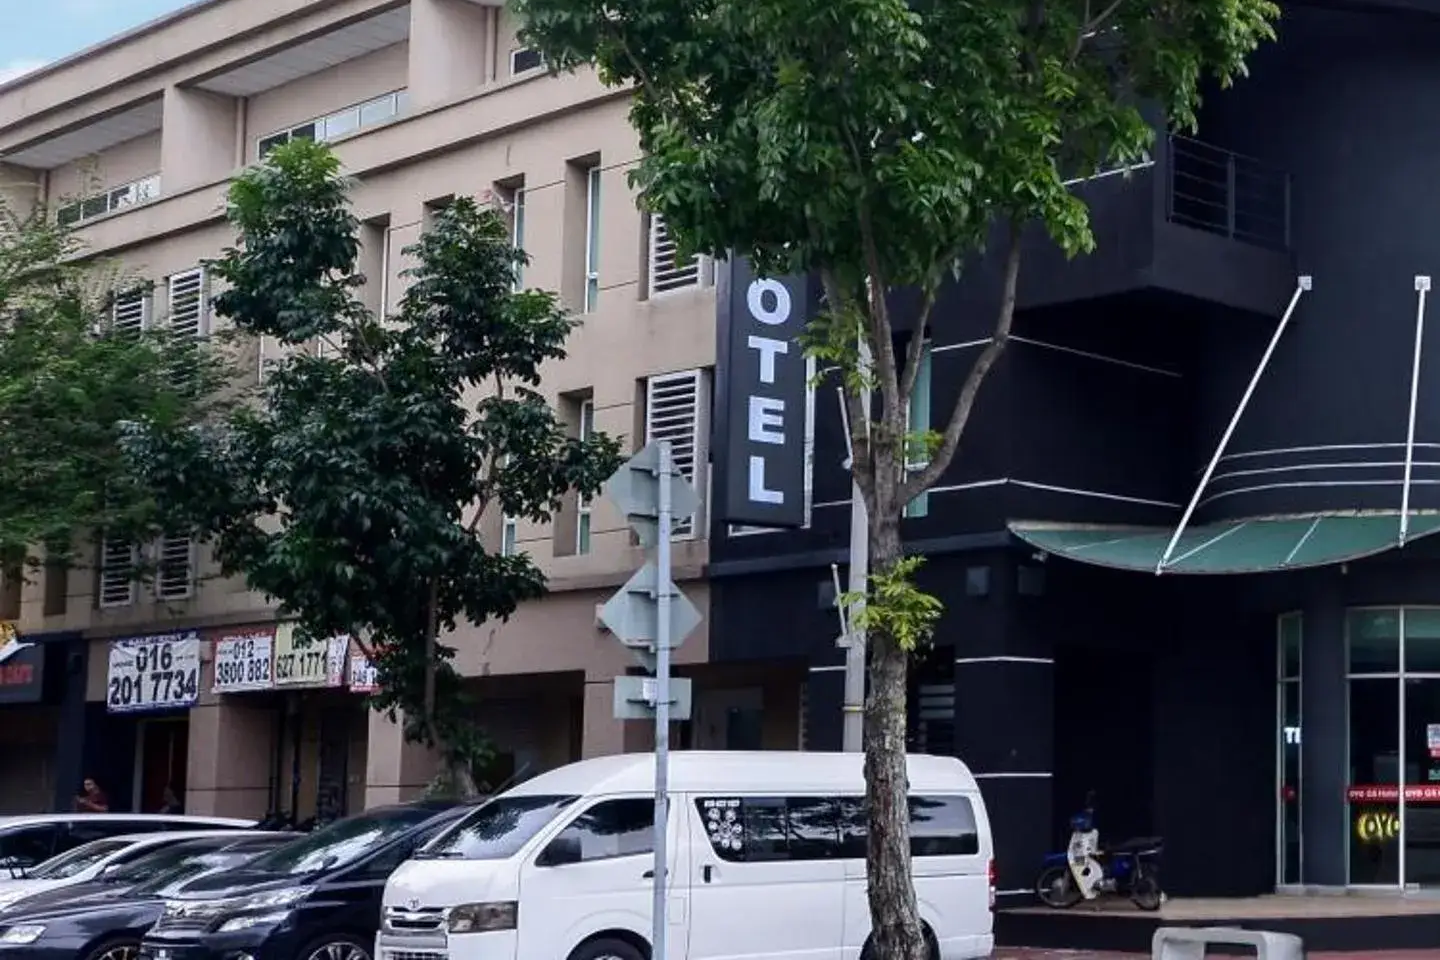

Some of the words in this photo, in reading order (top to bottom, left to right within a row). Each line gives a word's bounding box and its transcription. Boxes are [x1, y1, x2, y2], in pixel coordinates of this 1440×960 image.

[747, 278, 791, 504] OTEL
[136, 643, 172, 672] 016
[233, 641, 254, 660] 012
[109, 674, 143, 705] 201
[150, 668, 197, 701] 7734
